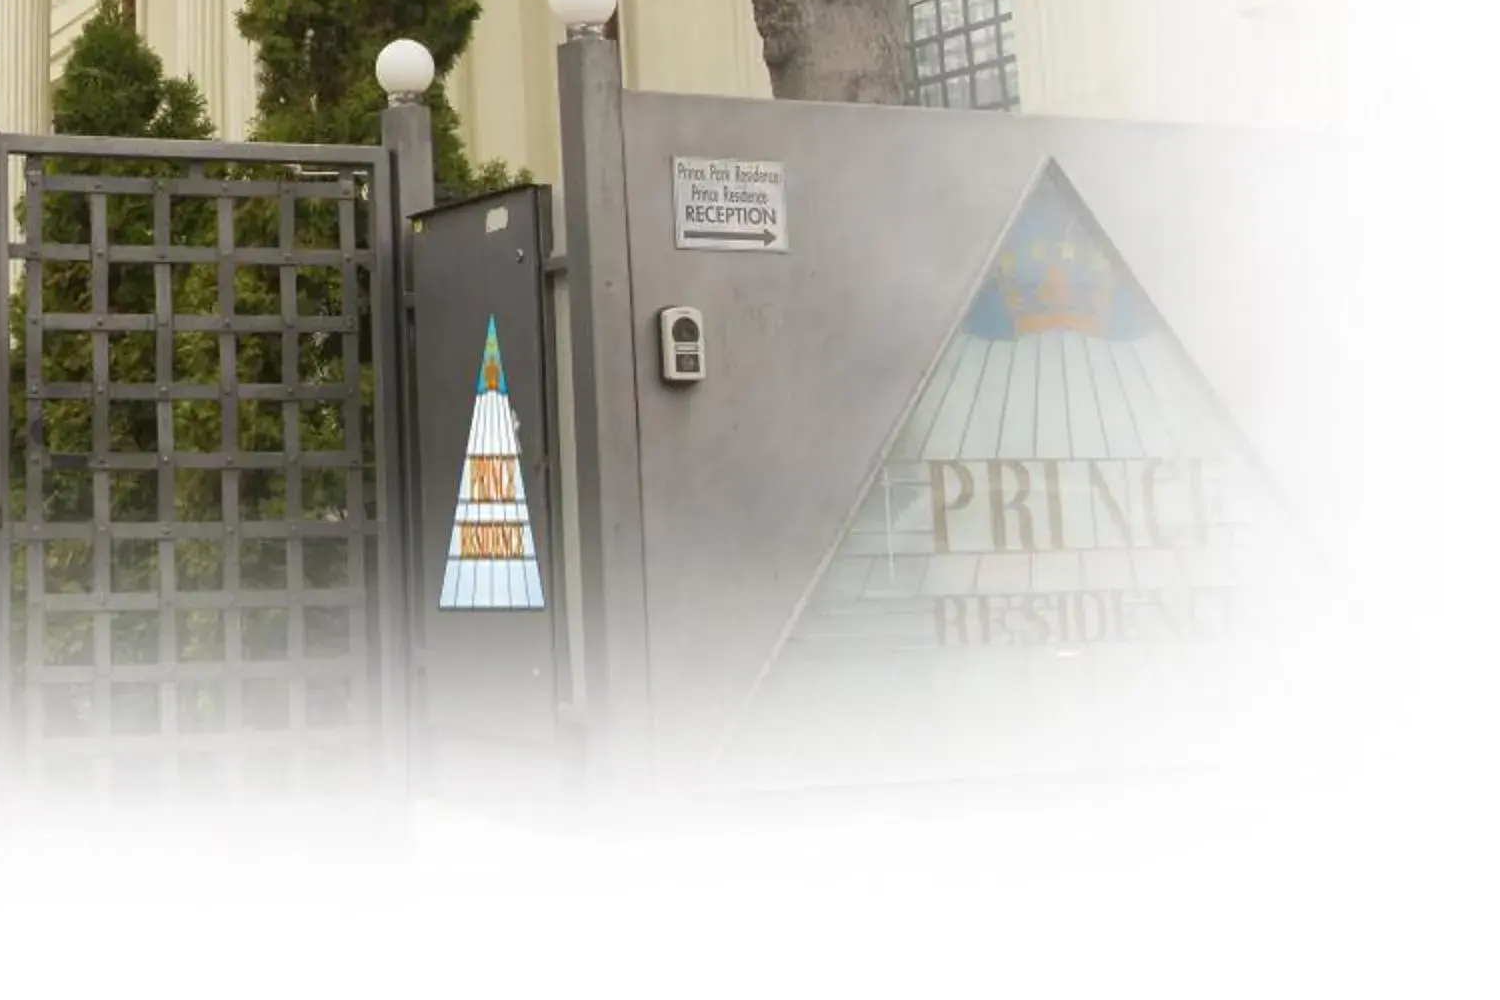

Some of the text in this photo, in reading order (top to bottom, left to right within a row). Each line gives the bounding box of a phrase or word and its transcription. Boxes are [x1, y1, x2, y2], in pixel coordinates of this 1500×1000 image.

[685, 205, 777, 225] RECEPTION
[469, 456, 516, 502] PRINCE
[461, 522, 525, 560] RESIDENCE
